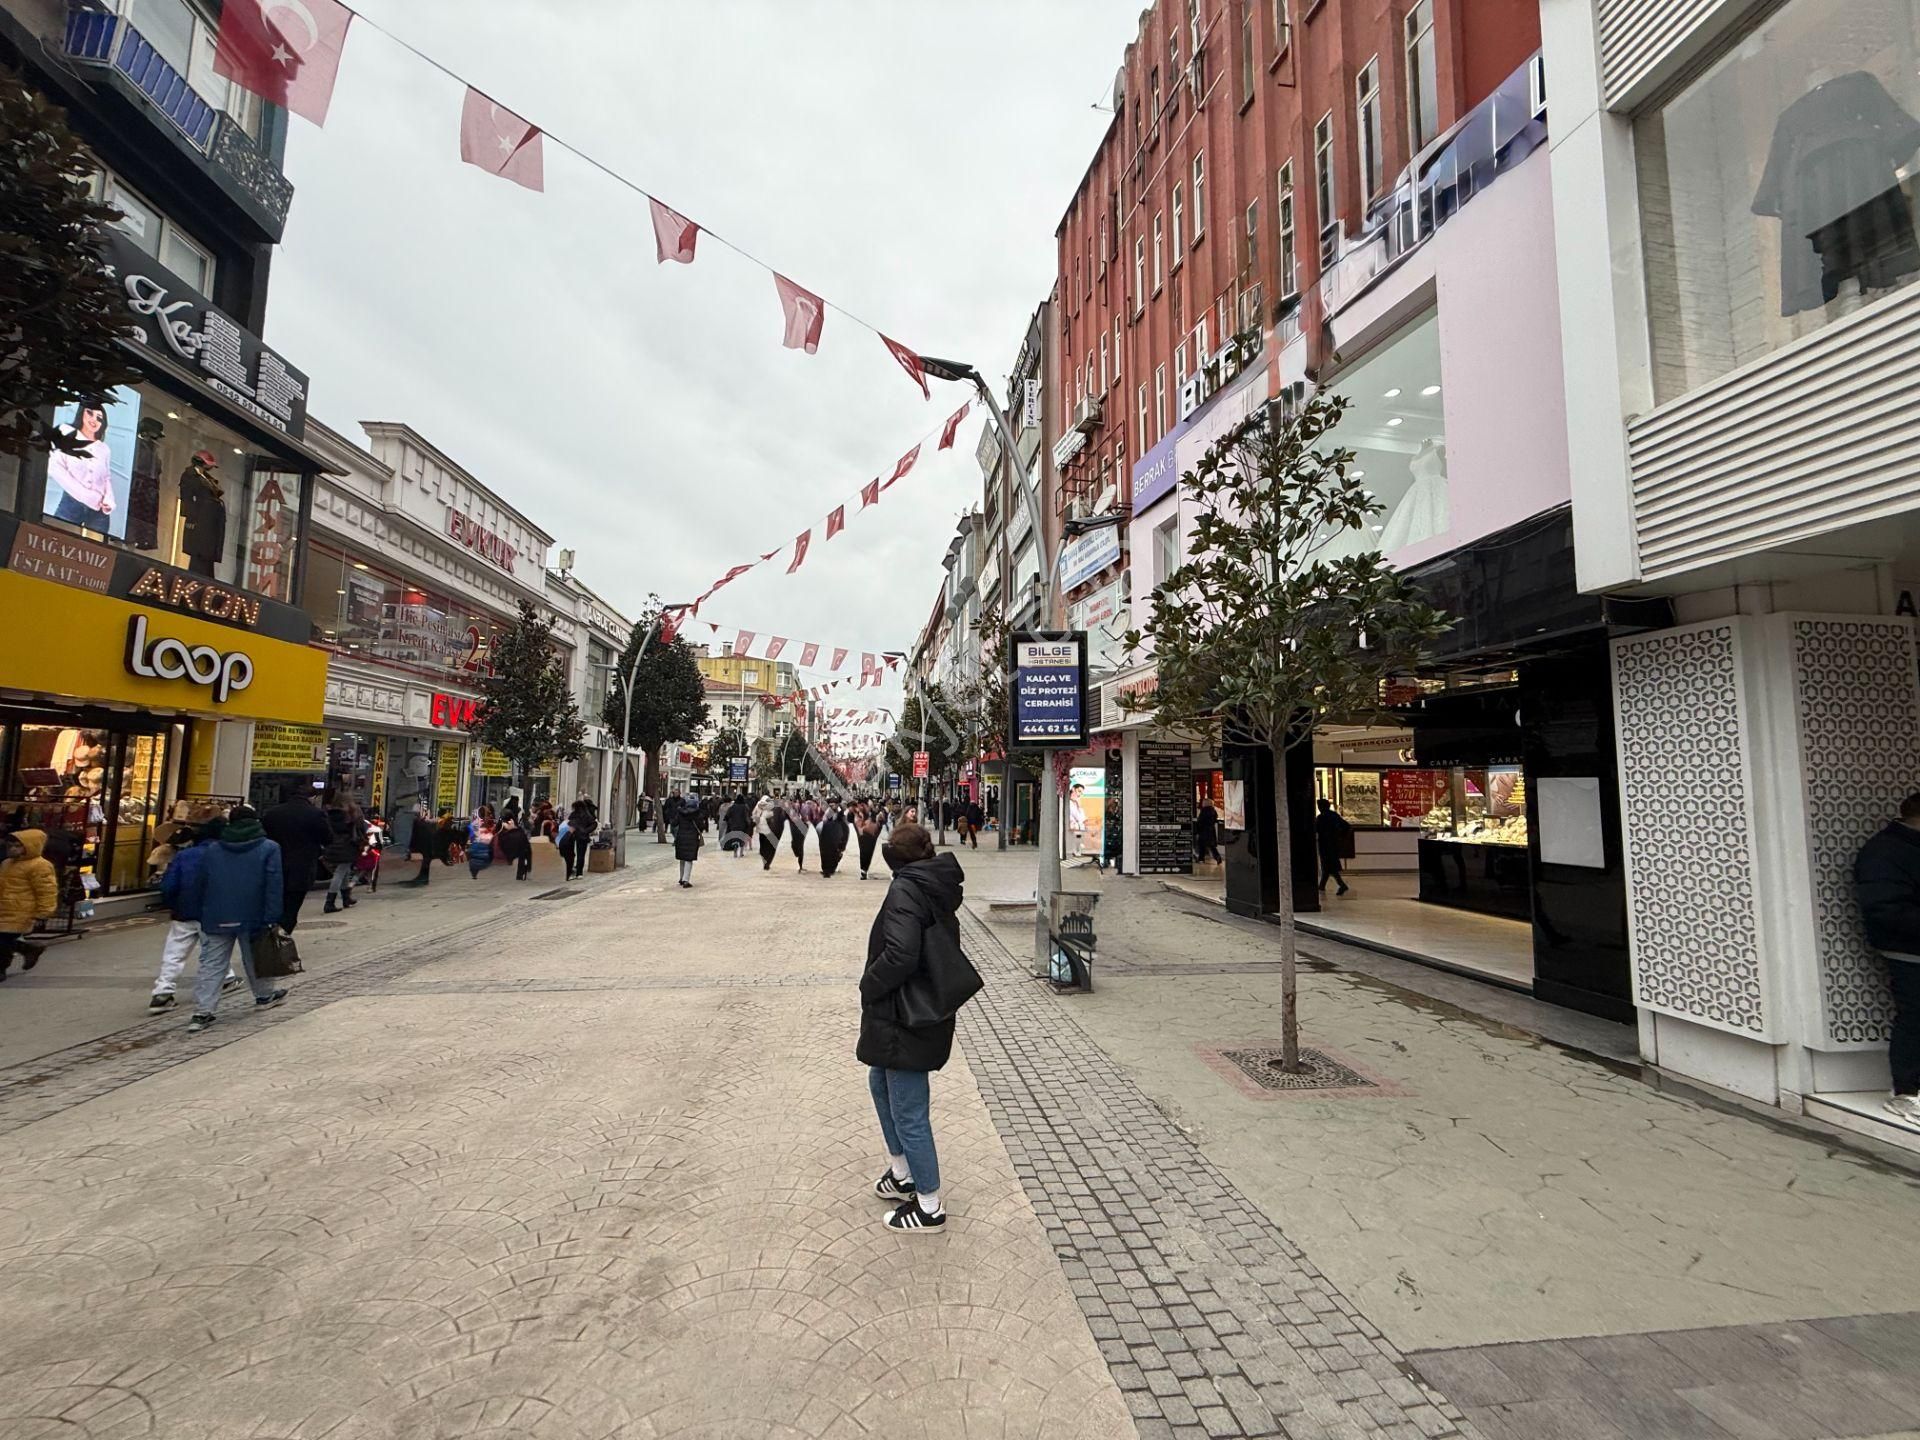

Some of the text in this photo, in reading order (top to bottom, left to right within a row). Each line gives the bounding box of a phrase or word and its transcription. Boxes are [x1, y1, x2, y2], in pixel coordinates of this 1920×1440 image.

[217, 382, 240, 402] 0542
[1134, 455, 1166, 497] BERRAK
[27, 532, 108, 570] MAĞAZAMIZ
[450, 507, 517, 574] EVKUR
[13, 550, 43, 573] ÜST
[129, 567, 260, 626] AKON
[1020, 685, 1077, 695] DİZ PROTEZİ
[1026, 675, 1057, 684] KALÇA
[1025, 698, 1074, 708] CERRAHİSİ
[1023, 725, 1044, 733] 444
[1047, 725, 1060, 733] 62
[373, 740, 385, 806] KAMPAN
